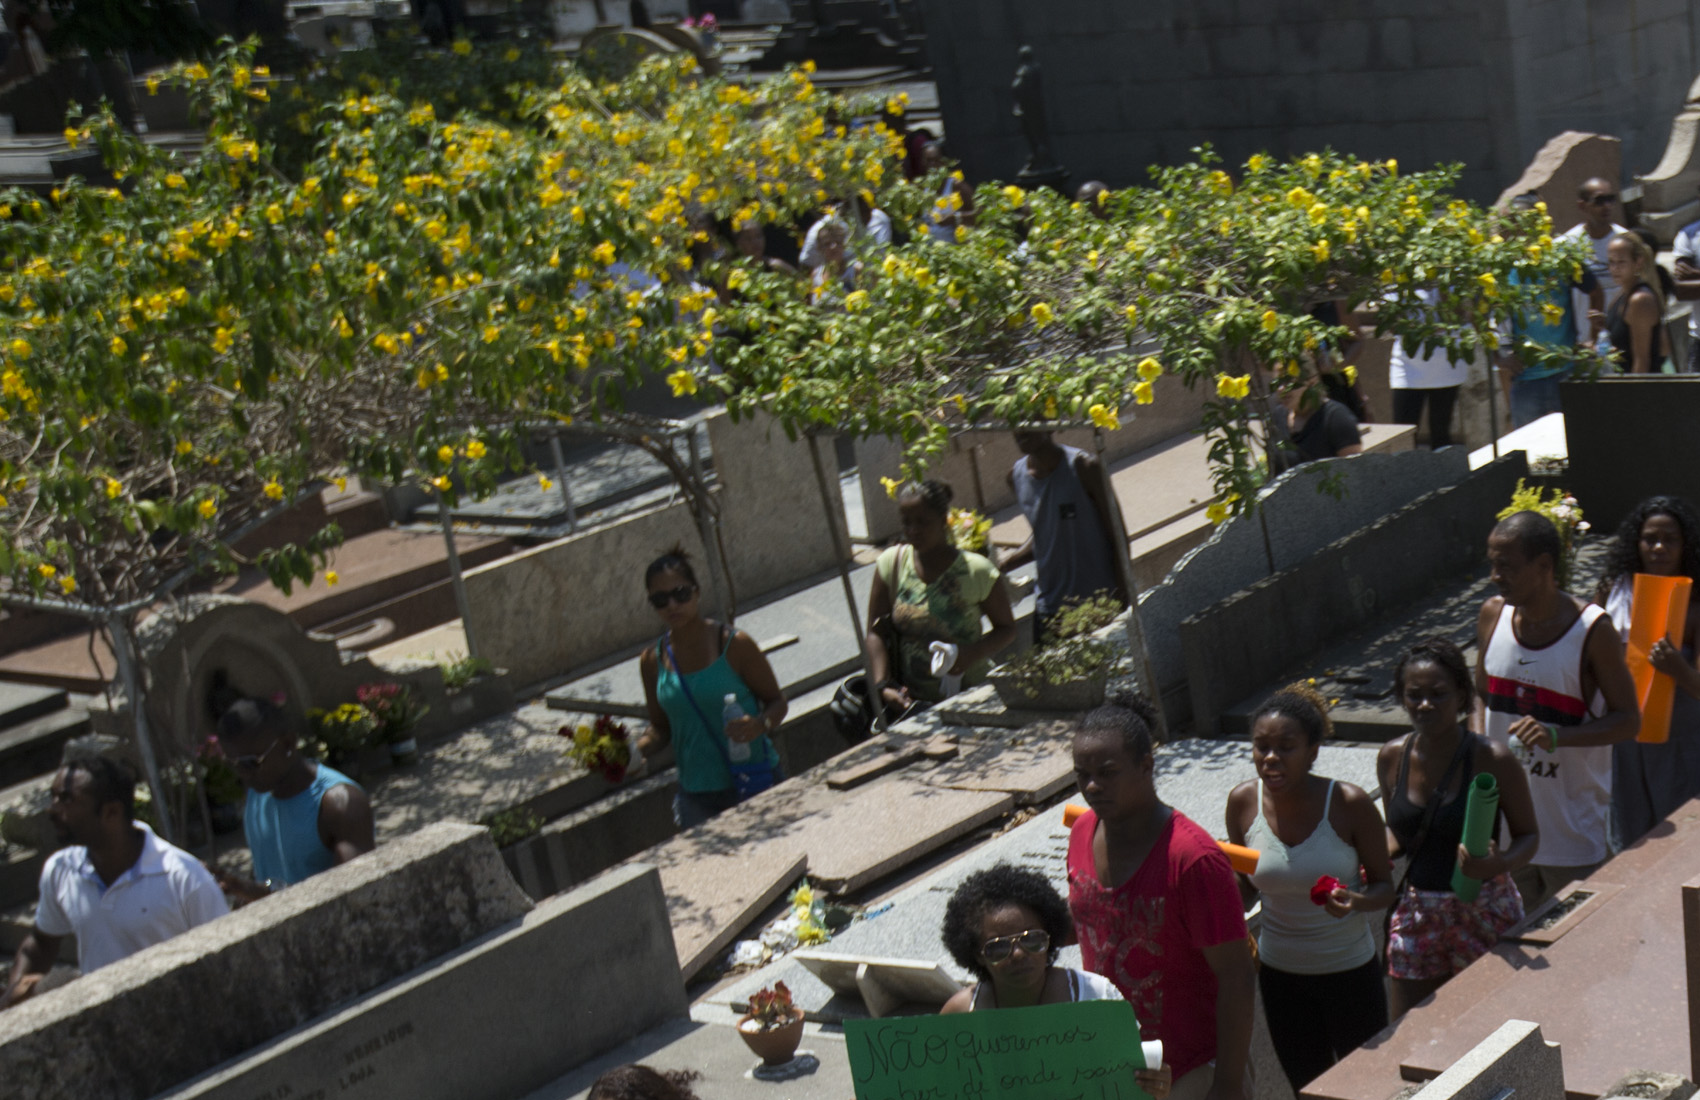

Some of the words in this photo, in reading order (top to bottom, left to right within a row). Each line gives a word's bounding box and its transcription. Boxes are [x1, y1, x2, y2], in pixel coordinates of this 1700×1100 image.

[955, 1026, 1097, 1075] queremos
[963, 1068, 989, 1096] de
[1000, 1059, 1061, 1090] onde
